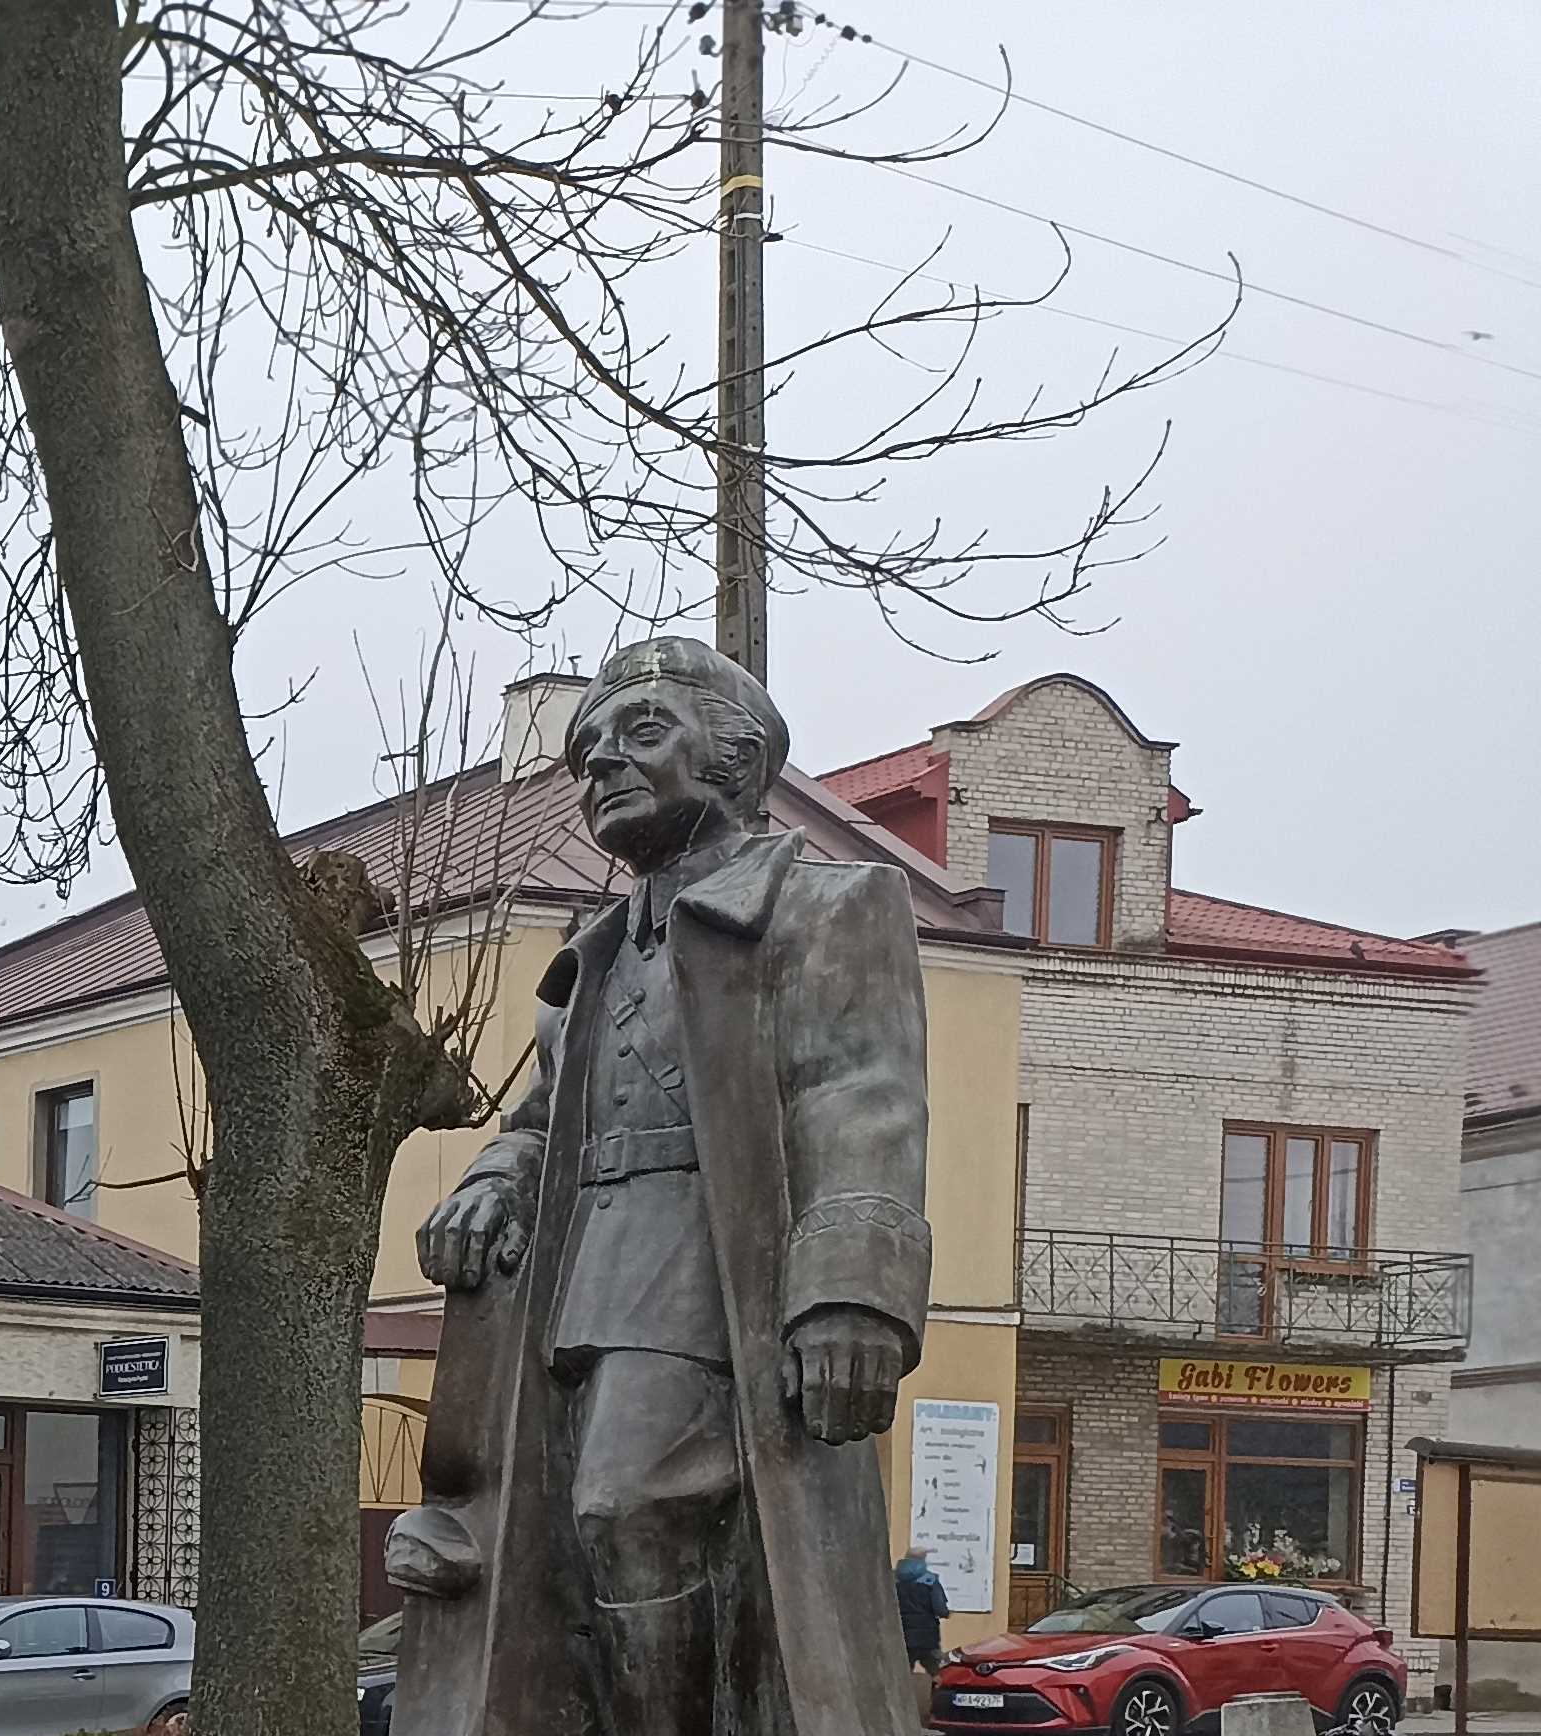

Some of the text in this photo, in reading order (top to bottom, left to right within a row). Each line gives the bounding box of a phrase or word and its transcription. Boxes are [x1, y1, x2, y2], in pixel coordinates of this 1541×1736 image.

[1177, 1362, 1353, 1394] Gabi Flowers
[101, 1582, 110, 1597] 9
